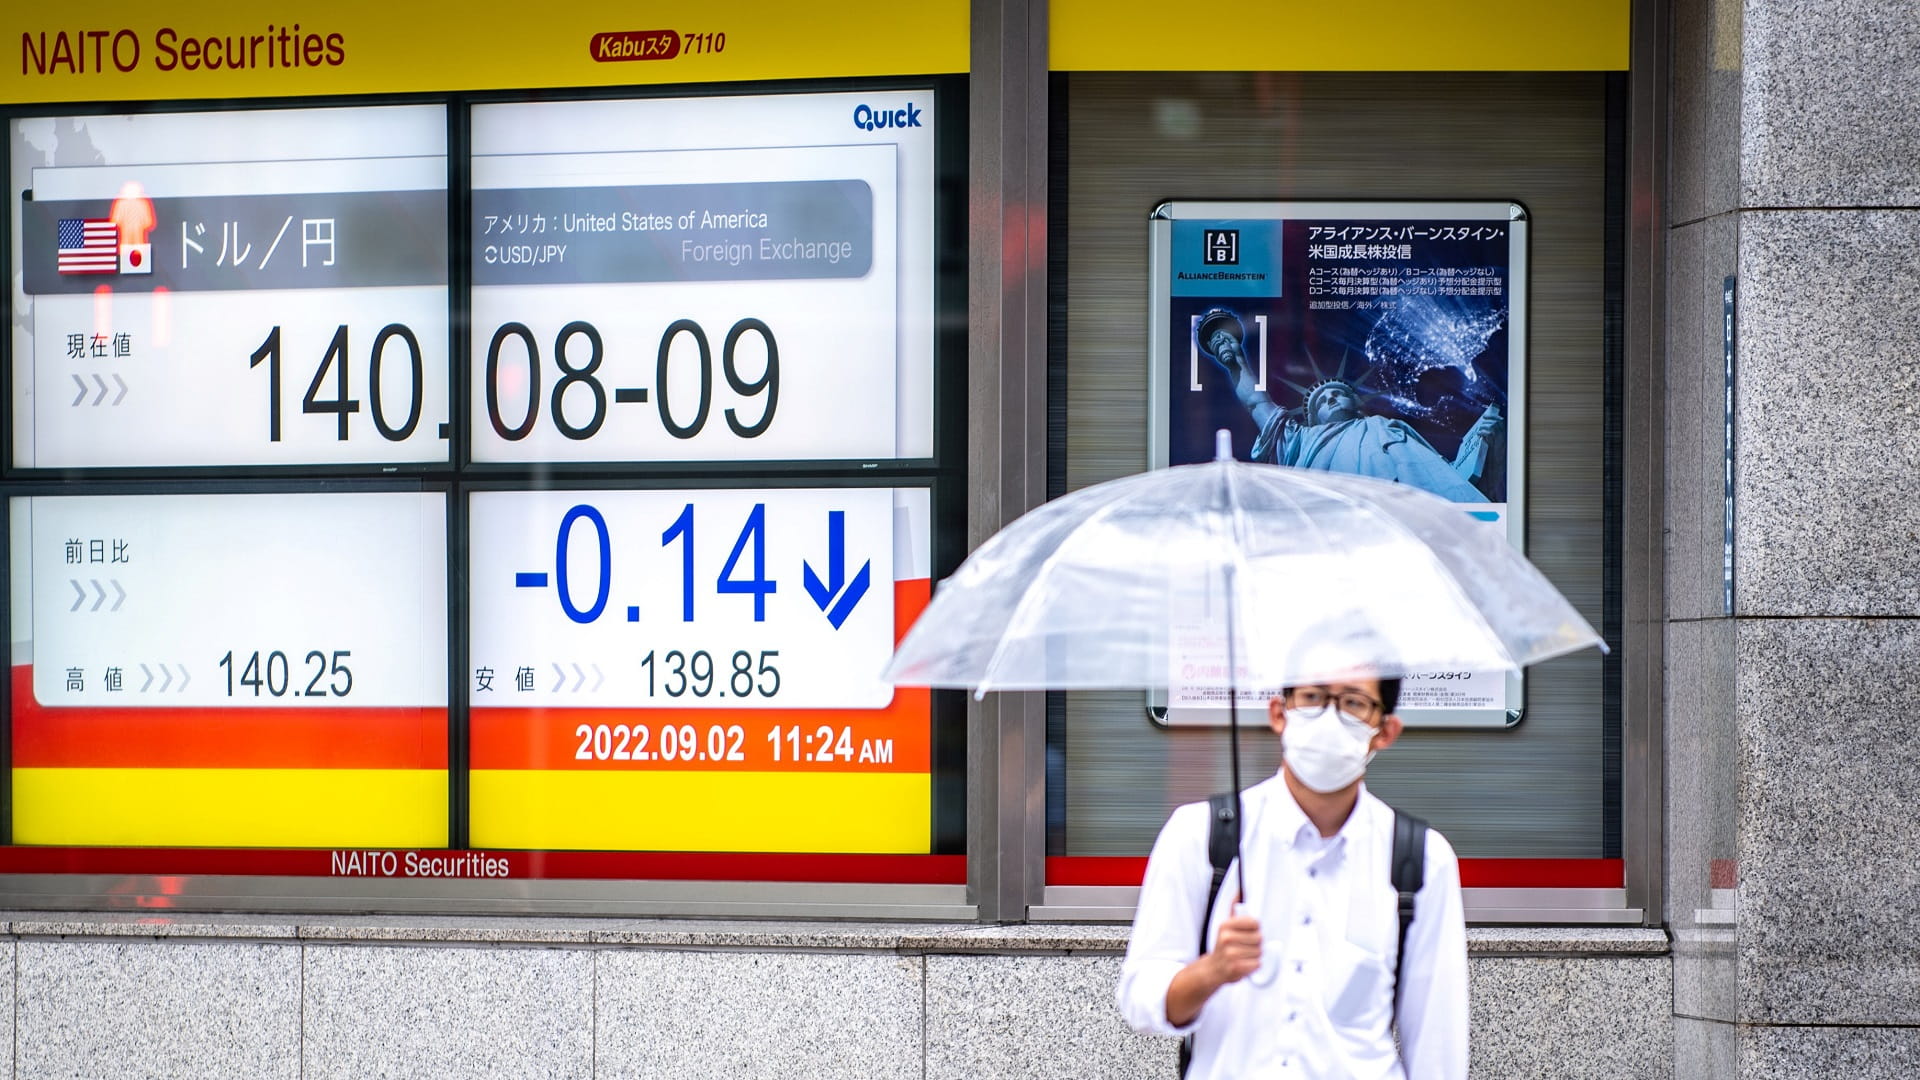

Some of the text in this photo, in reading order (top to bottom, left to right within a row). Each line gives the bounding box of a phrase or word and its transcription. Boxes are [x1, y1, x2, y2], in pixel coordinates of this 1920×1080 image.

[21, 23, 345, 76] NAITO Securities
[598, 32, 726, 59] Kabuスタ 7110
[563, 213, 616, 233] United
[621, 212, 673, 231] States
[678, 210, 696, 230] of
[700, 208, 768, 229] America
[499, 245, 567, 266] USD/JPY
[681, 236, 853, 266] Foreign Exchange
[1308, 244, 1412, 260] 米国成長株投信
[66, 332, 131, 359] 現在値
[64, 538, 130, 565] 前日比
[515, 503, 777, 624] -0.14
[219, 650, 353, 698] 140.25
[641, 650, 781, 698] 139.85
[575, 724, 893, 764] 2022.09.02 11:24 AM
[331, 852, 509, 878] NAITO Securities
